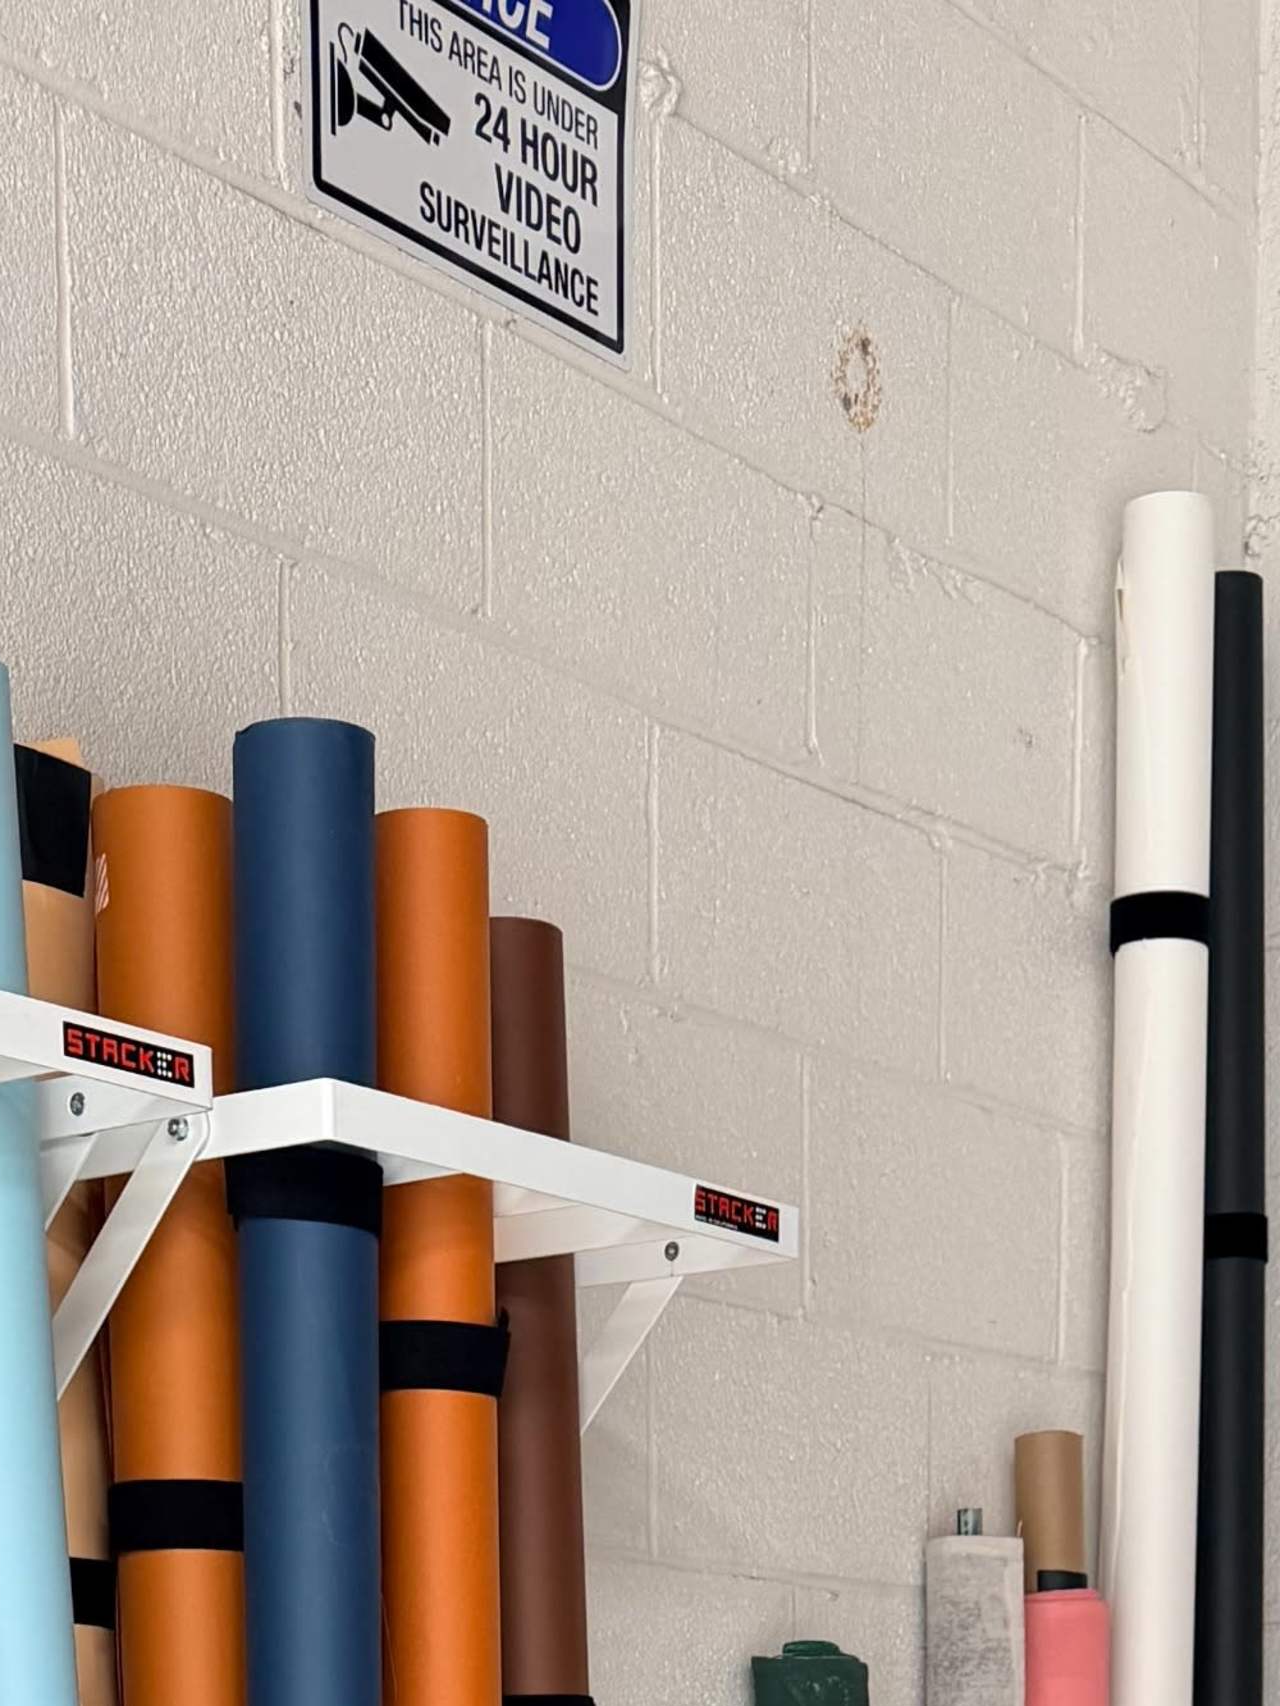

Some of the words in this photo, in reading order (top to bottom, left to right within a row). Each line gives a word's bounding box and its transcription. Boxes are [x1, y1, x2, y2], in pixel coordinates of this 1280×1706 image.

[400, 0, 443, 53] THIS
[448, 31, 502, 91] AREA
[509, 66, 526, 104] IS
[534, 81, 598, 150] UNDER
[475, 93, 510, 153] 24
[521, 118, 598, 207] HOUR
[420, 181, 598, 316] SURVEILLANCE
[495, 163, 581, 254] VIDEO
[66, 1028, 191, 1082] STACKER
[694, 1189, 777, 1232] STACKER
